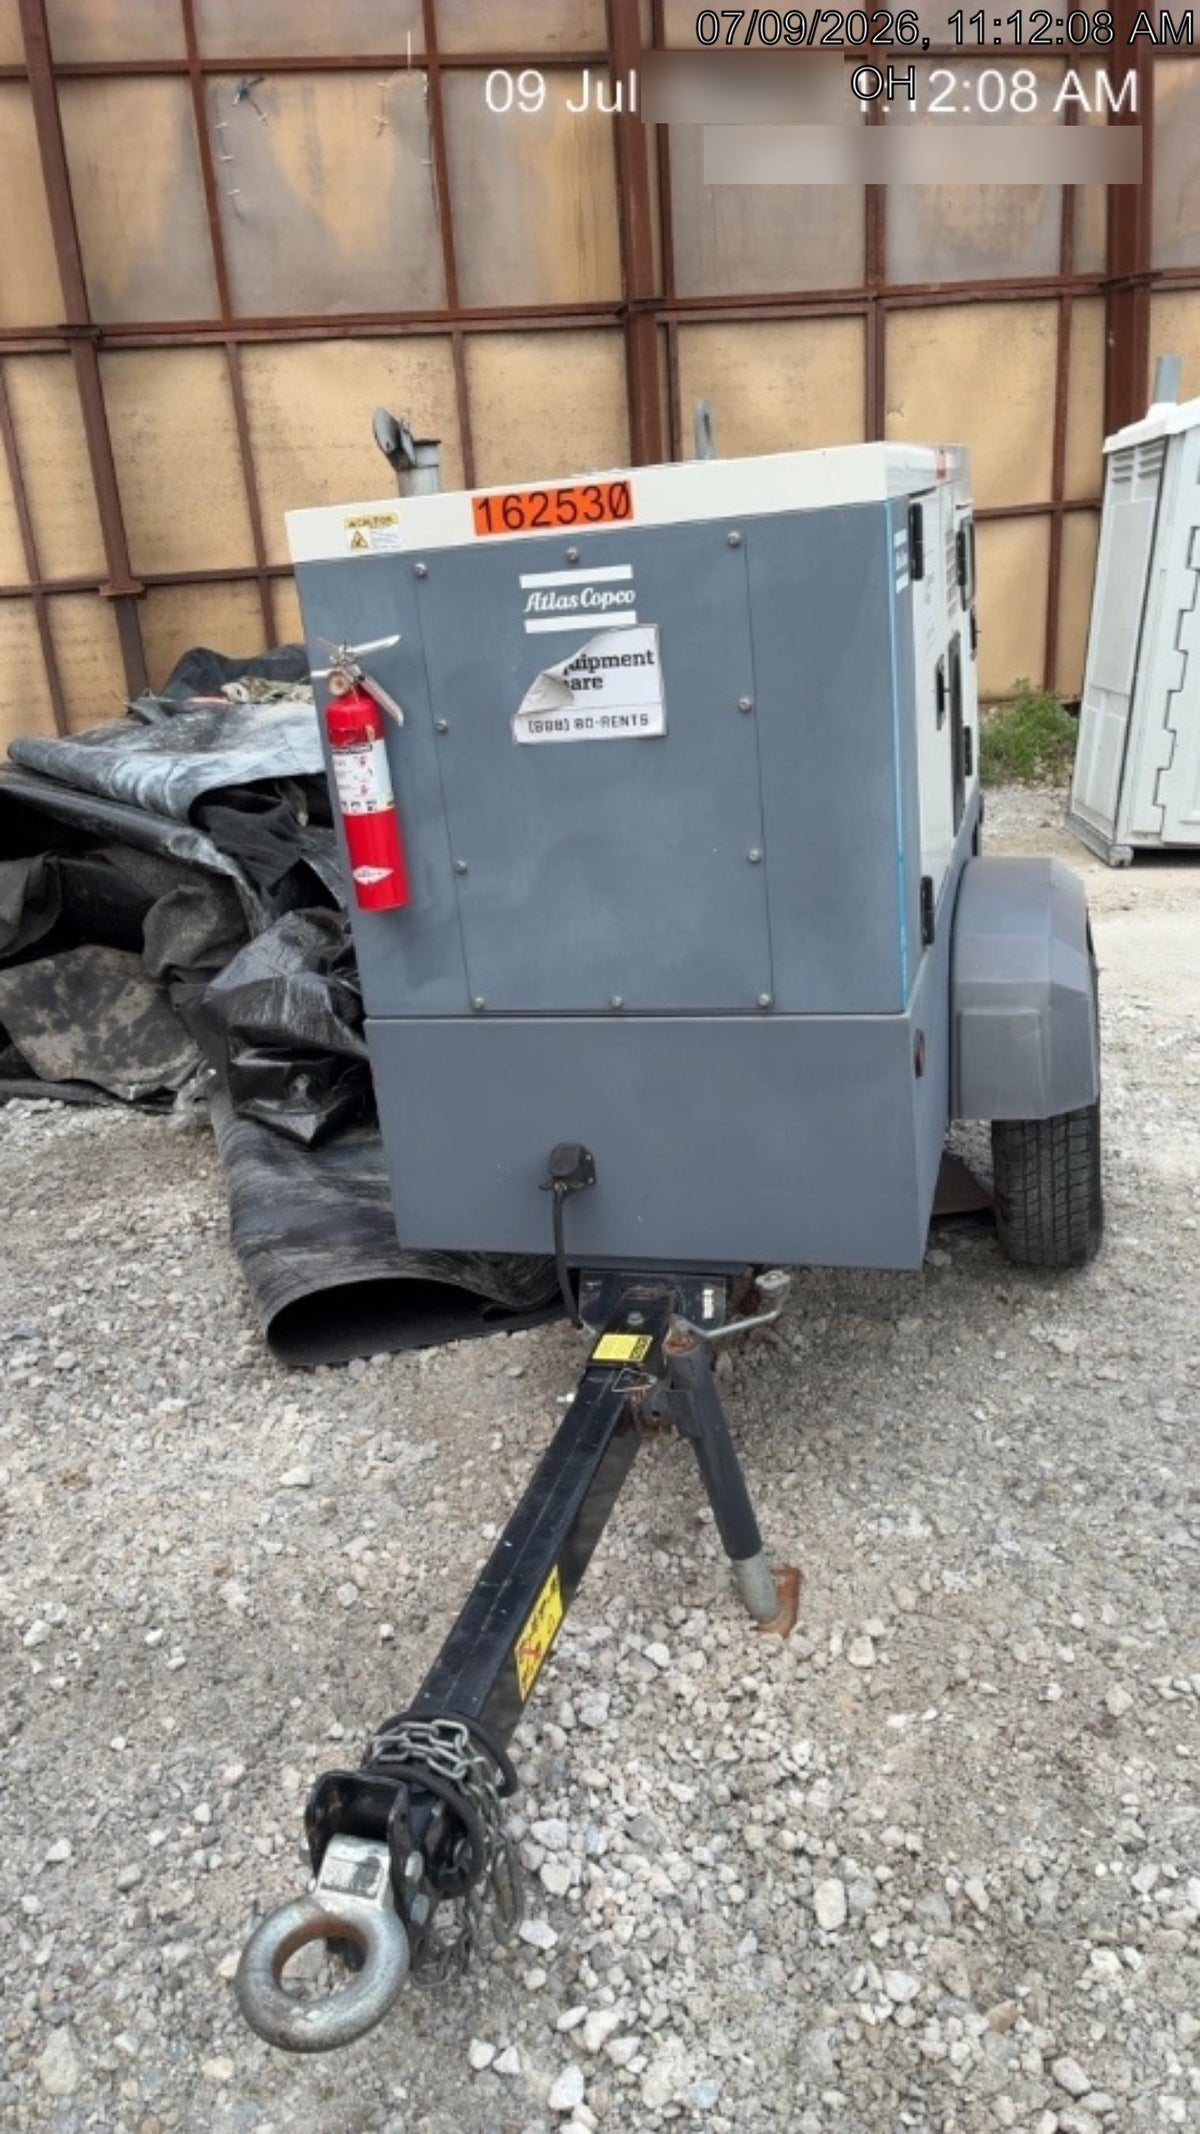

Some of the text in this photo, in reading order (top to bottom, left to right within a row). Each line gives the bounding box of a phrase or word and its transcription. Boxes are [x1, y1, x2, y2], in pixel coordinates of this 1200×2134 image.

[478, 480, 631, 532] 162530
[523, 587, 636, 612] Atlas Copco
[563, 649, 655, 676] uipment
[564, 676, 604, 691] are
